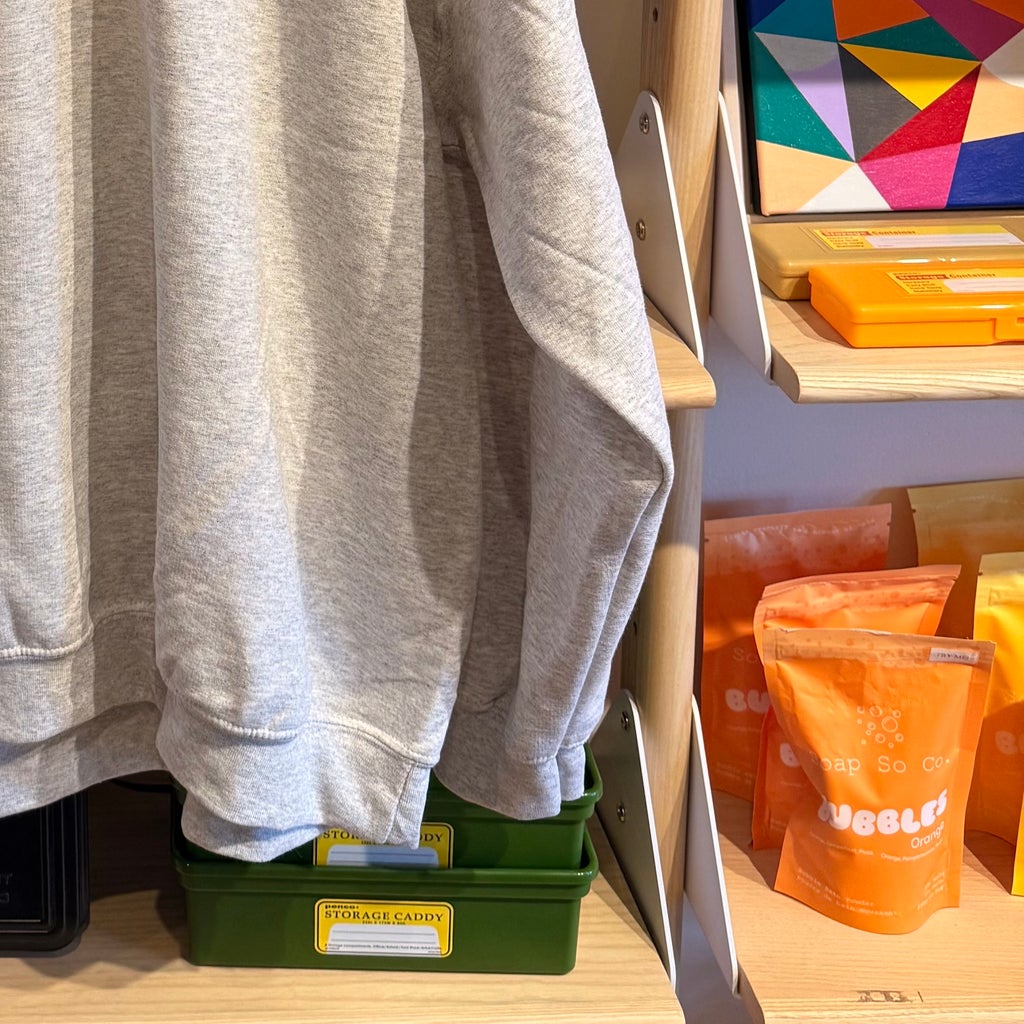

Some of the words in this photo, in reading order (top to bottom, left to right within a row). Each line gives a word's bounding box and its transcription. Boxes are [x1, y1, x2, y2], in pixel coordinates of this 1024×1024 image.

[878, 755, 907, 774] So
[922, 755, 951, 772] Co.
[325, 910, 390, 921] STORAGE
[394, 911, 443, 922] CADDY
